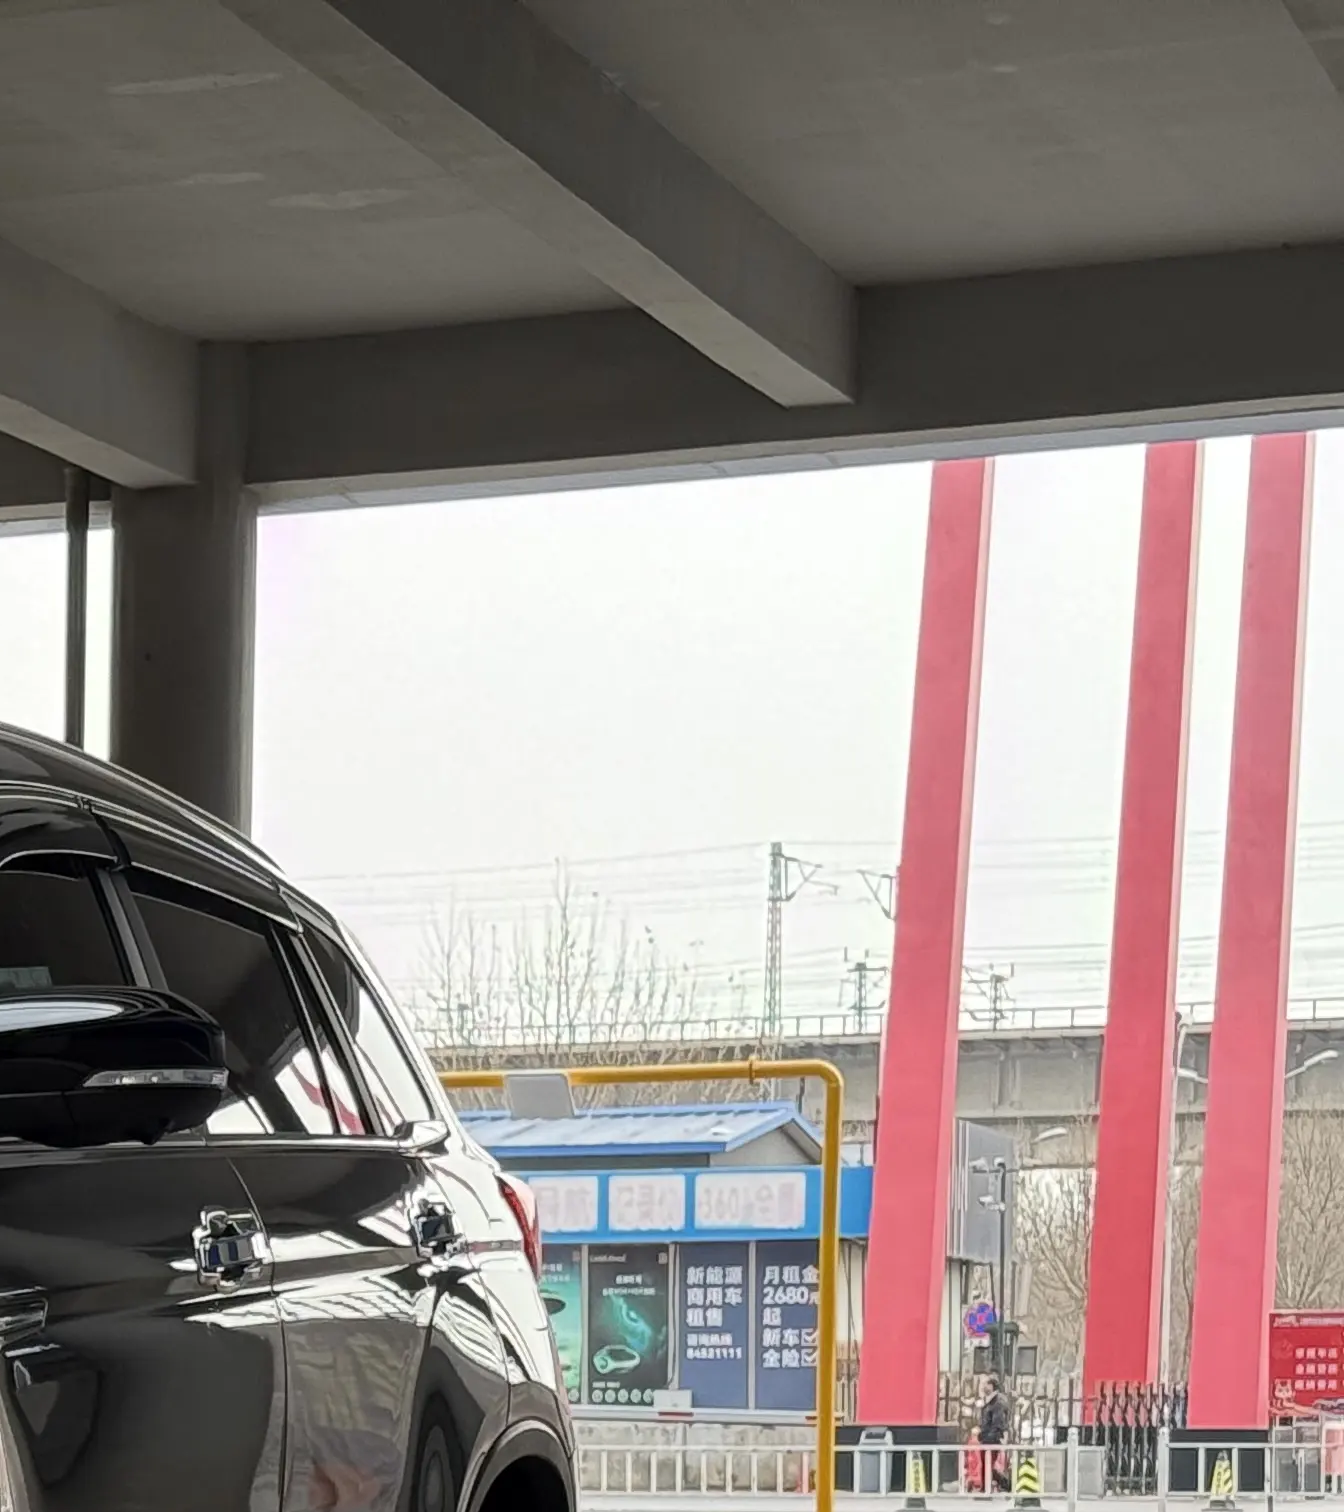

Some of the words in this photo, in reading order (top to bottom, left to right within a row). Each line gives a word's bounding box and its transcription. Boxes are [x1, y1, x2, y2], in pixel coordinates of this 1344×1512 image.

[686, 1265, 743, 1285] 新能源
[763, 1265, 819, 1285] 月租金
